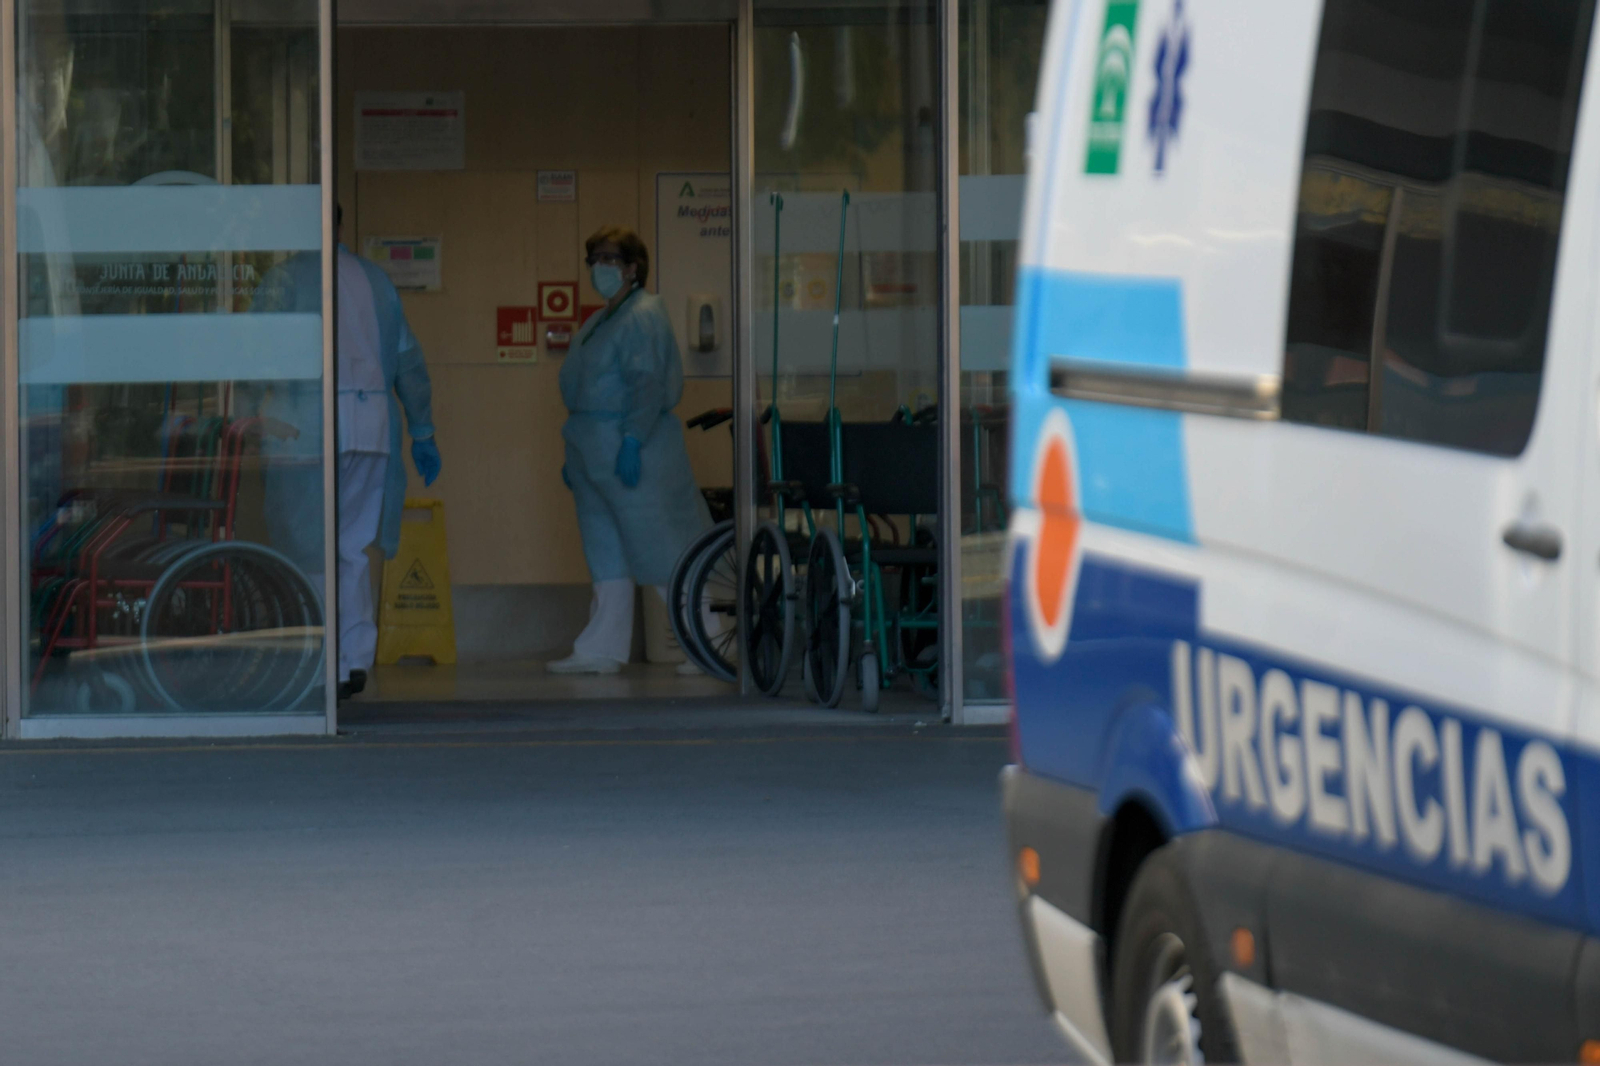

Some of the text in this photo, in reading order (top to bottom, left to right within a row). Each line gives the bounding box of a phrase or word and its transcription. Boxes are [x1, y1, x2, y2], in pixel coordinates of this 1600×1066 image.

[99, 264, 255, 281] JUNTA DE ANDALCIA
[122, 286, 132, 295] DE
[1172, 638, 1572, 896] URGENCIAS
